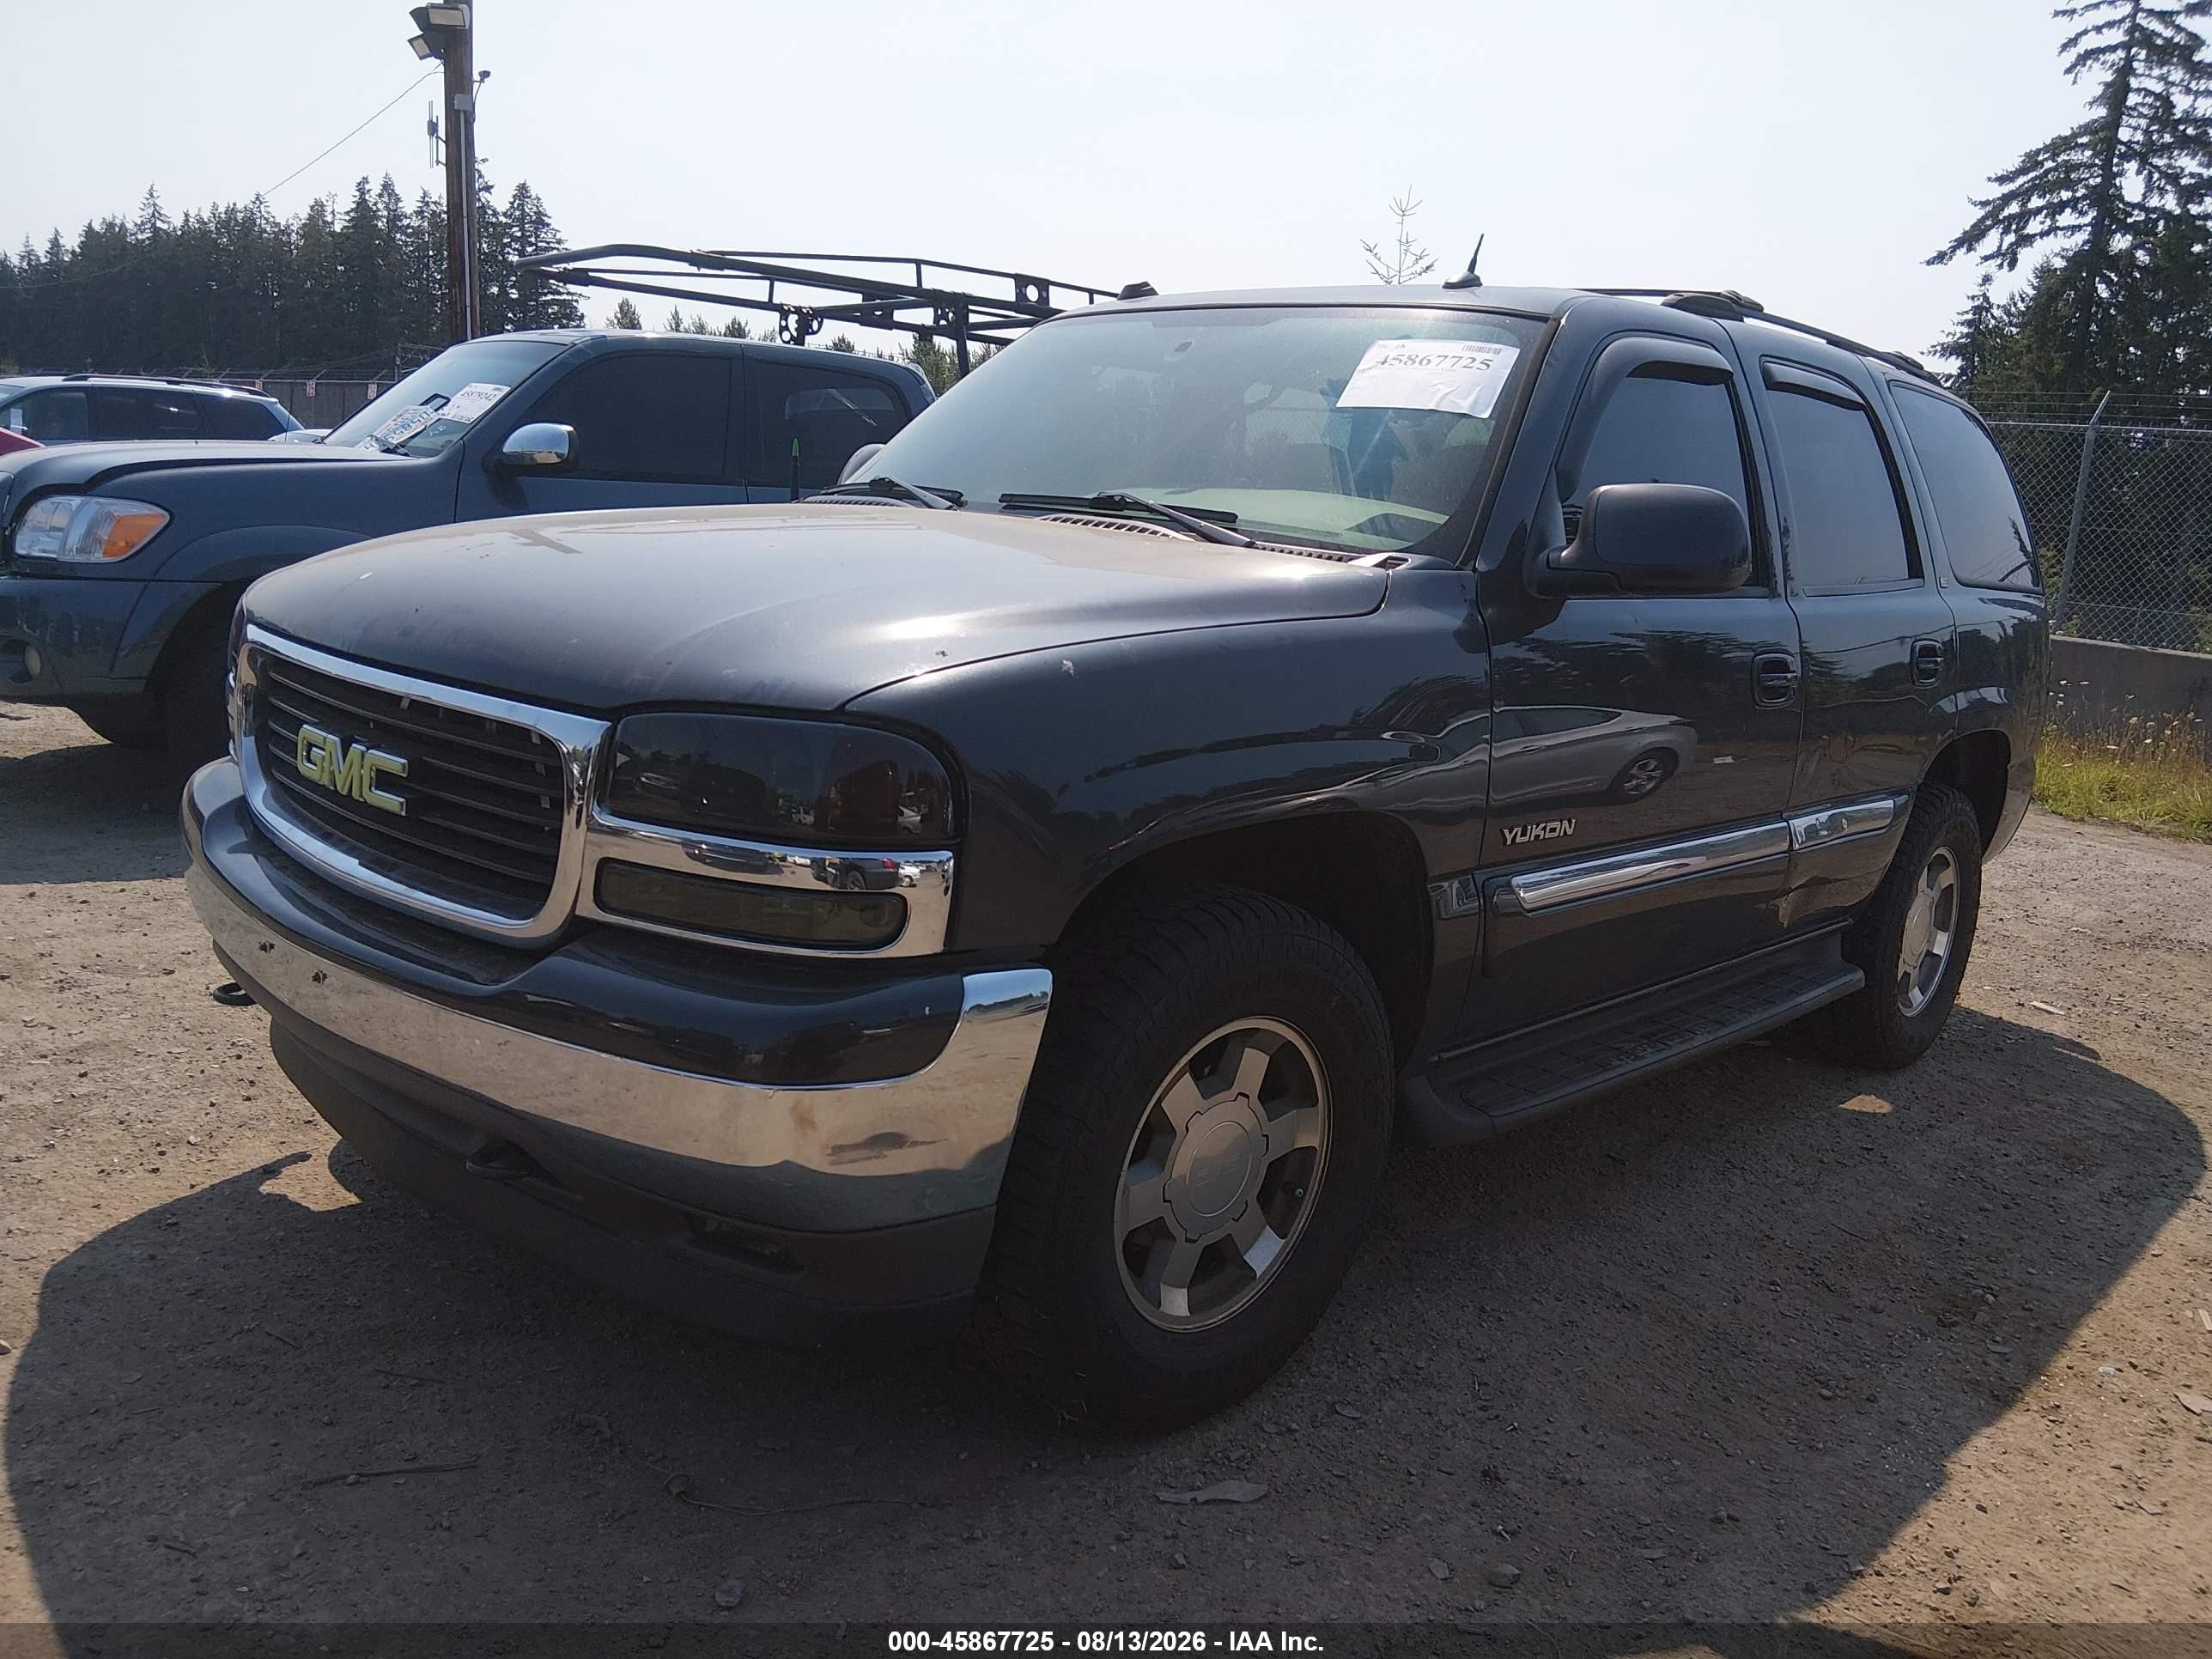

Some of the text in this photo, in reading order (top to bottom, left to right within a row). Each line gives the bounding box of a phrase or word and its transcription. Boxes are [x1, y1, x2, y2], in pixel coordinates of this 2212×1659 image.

[1375, 353, 1494, 371] 45867725
[296, 724, 409, 816] GMC
[1503, 818, 1576, 845] YUKON
